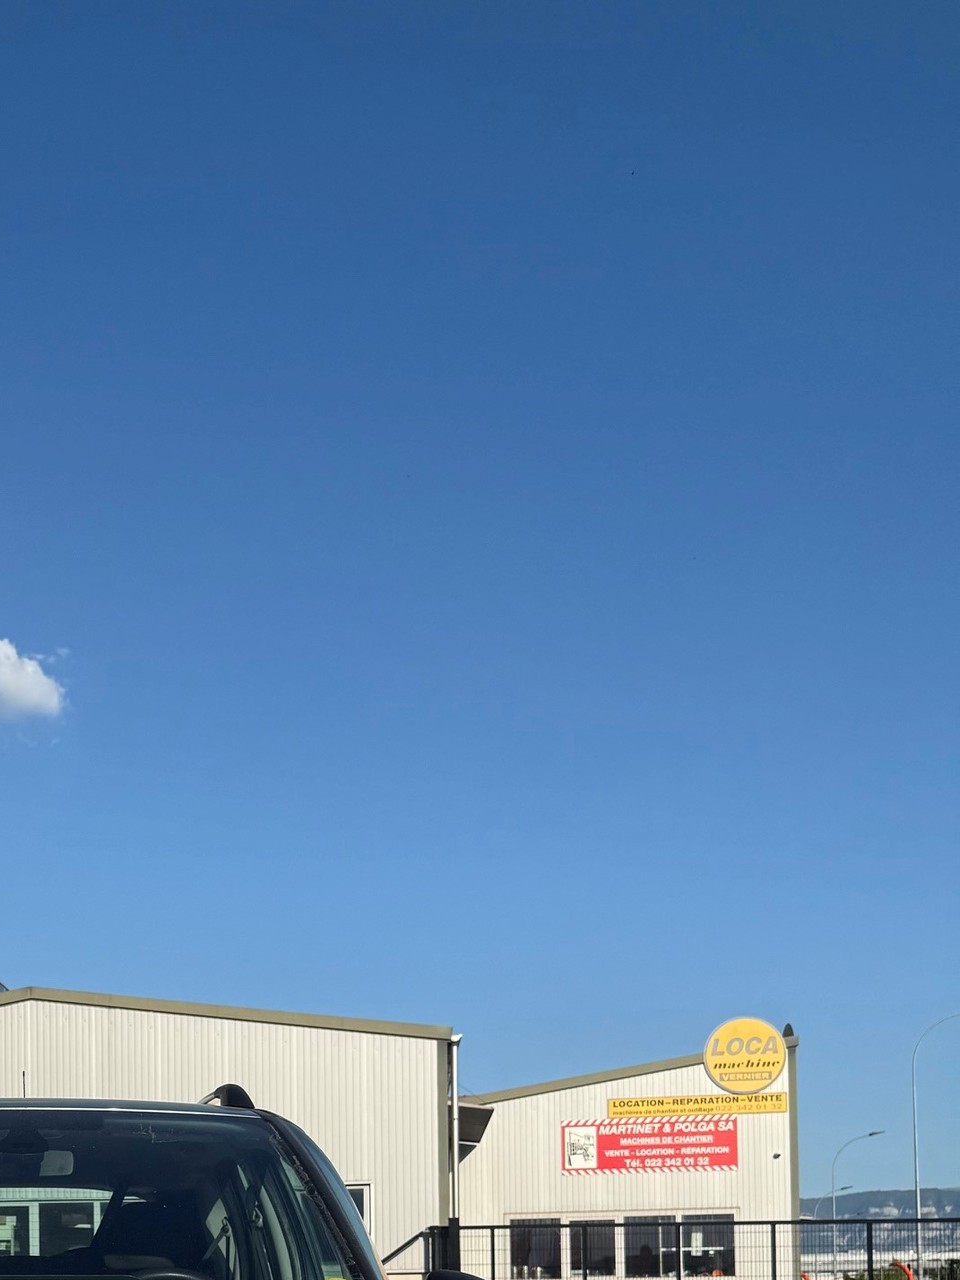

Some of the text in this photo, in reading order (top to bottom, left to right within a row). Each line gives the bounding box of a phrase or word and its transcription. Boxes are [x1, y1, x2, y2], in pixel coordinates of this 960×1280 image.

[711, 1036, 778, 1056] LOCA
[713, 1059, 780, 1069] machine
[722, 1071, 769, 1081] VERNIER
[599, 1123, 662, 1135] MARTINET
[663, 1123, 671, 1133] &
[718, 1121, 734, 1131] SA
[620, 1135, 713, 1146] MACHINES DE CHANTIER
[604, 1149, 630, 1157] VENTE
[636, 1148, 674, 1156] LOCATION
[645, 1158, 662, 1167] 022
[664, 1157, 681, 1166] 342
[684, 1157, 694, 1165] 01
[697, 1156, 709, 1165] 32
